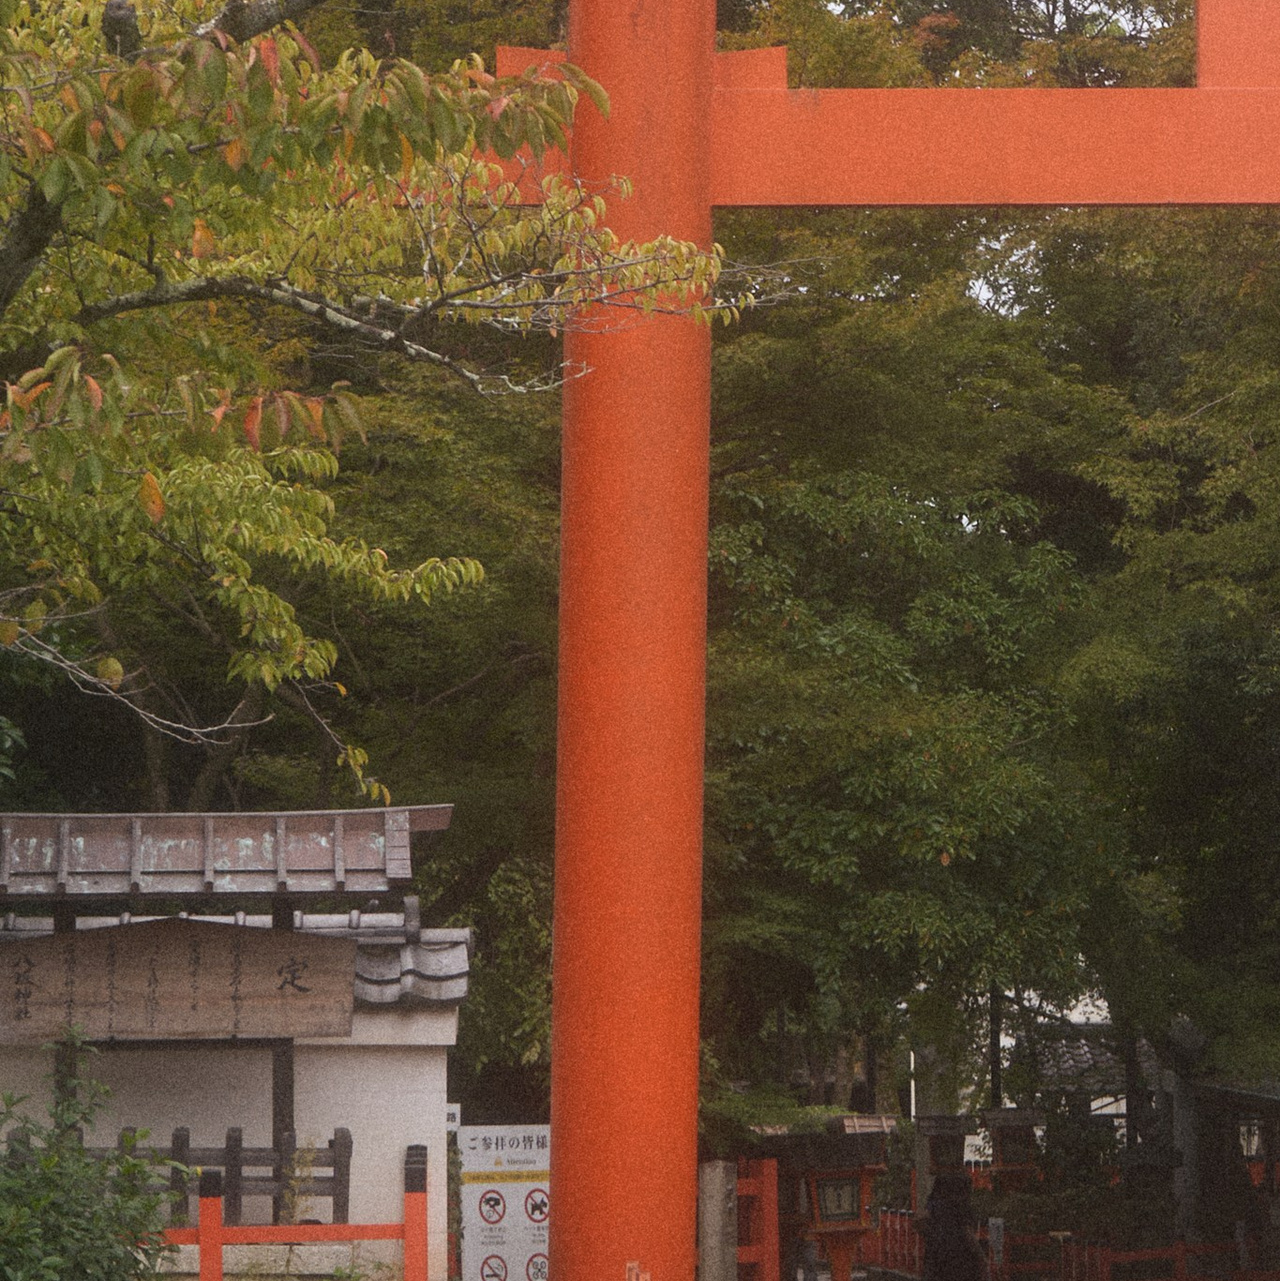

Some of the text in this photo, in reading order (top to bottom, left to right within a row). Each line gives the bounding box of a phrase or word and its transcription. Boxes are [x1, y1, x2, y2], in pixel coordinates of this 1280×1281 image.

[276, 957, 312, 993] 定
[468, 1134, 548, 1150] ご参拝の皆様
